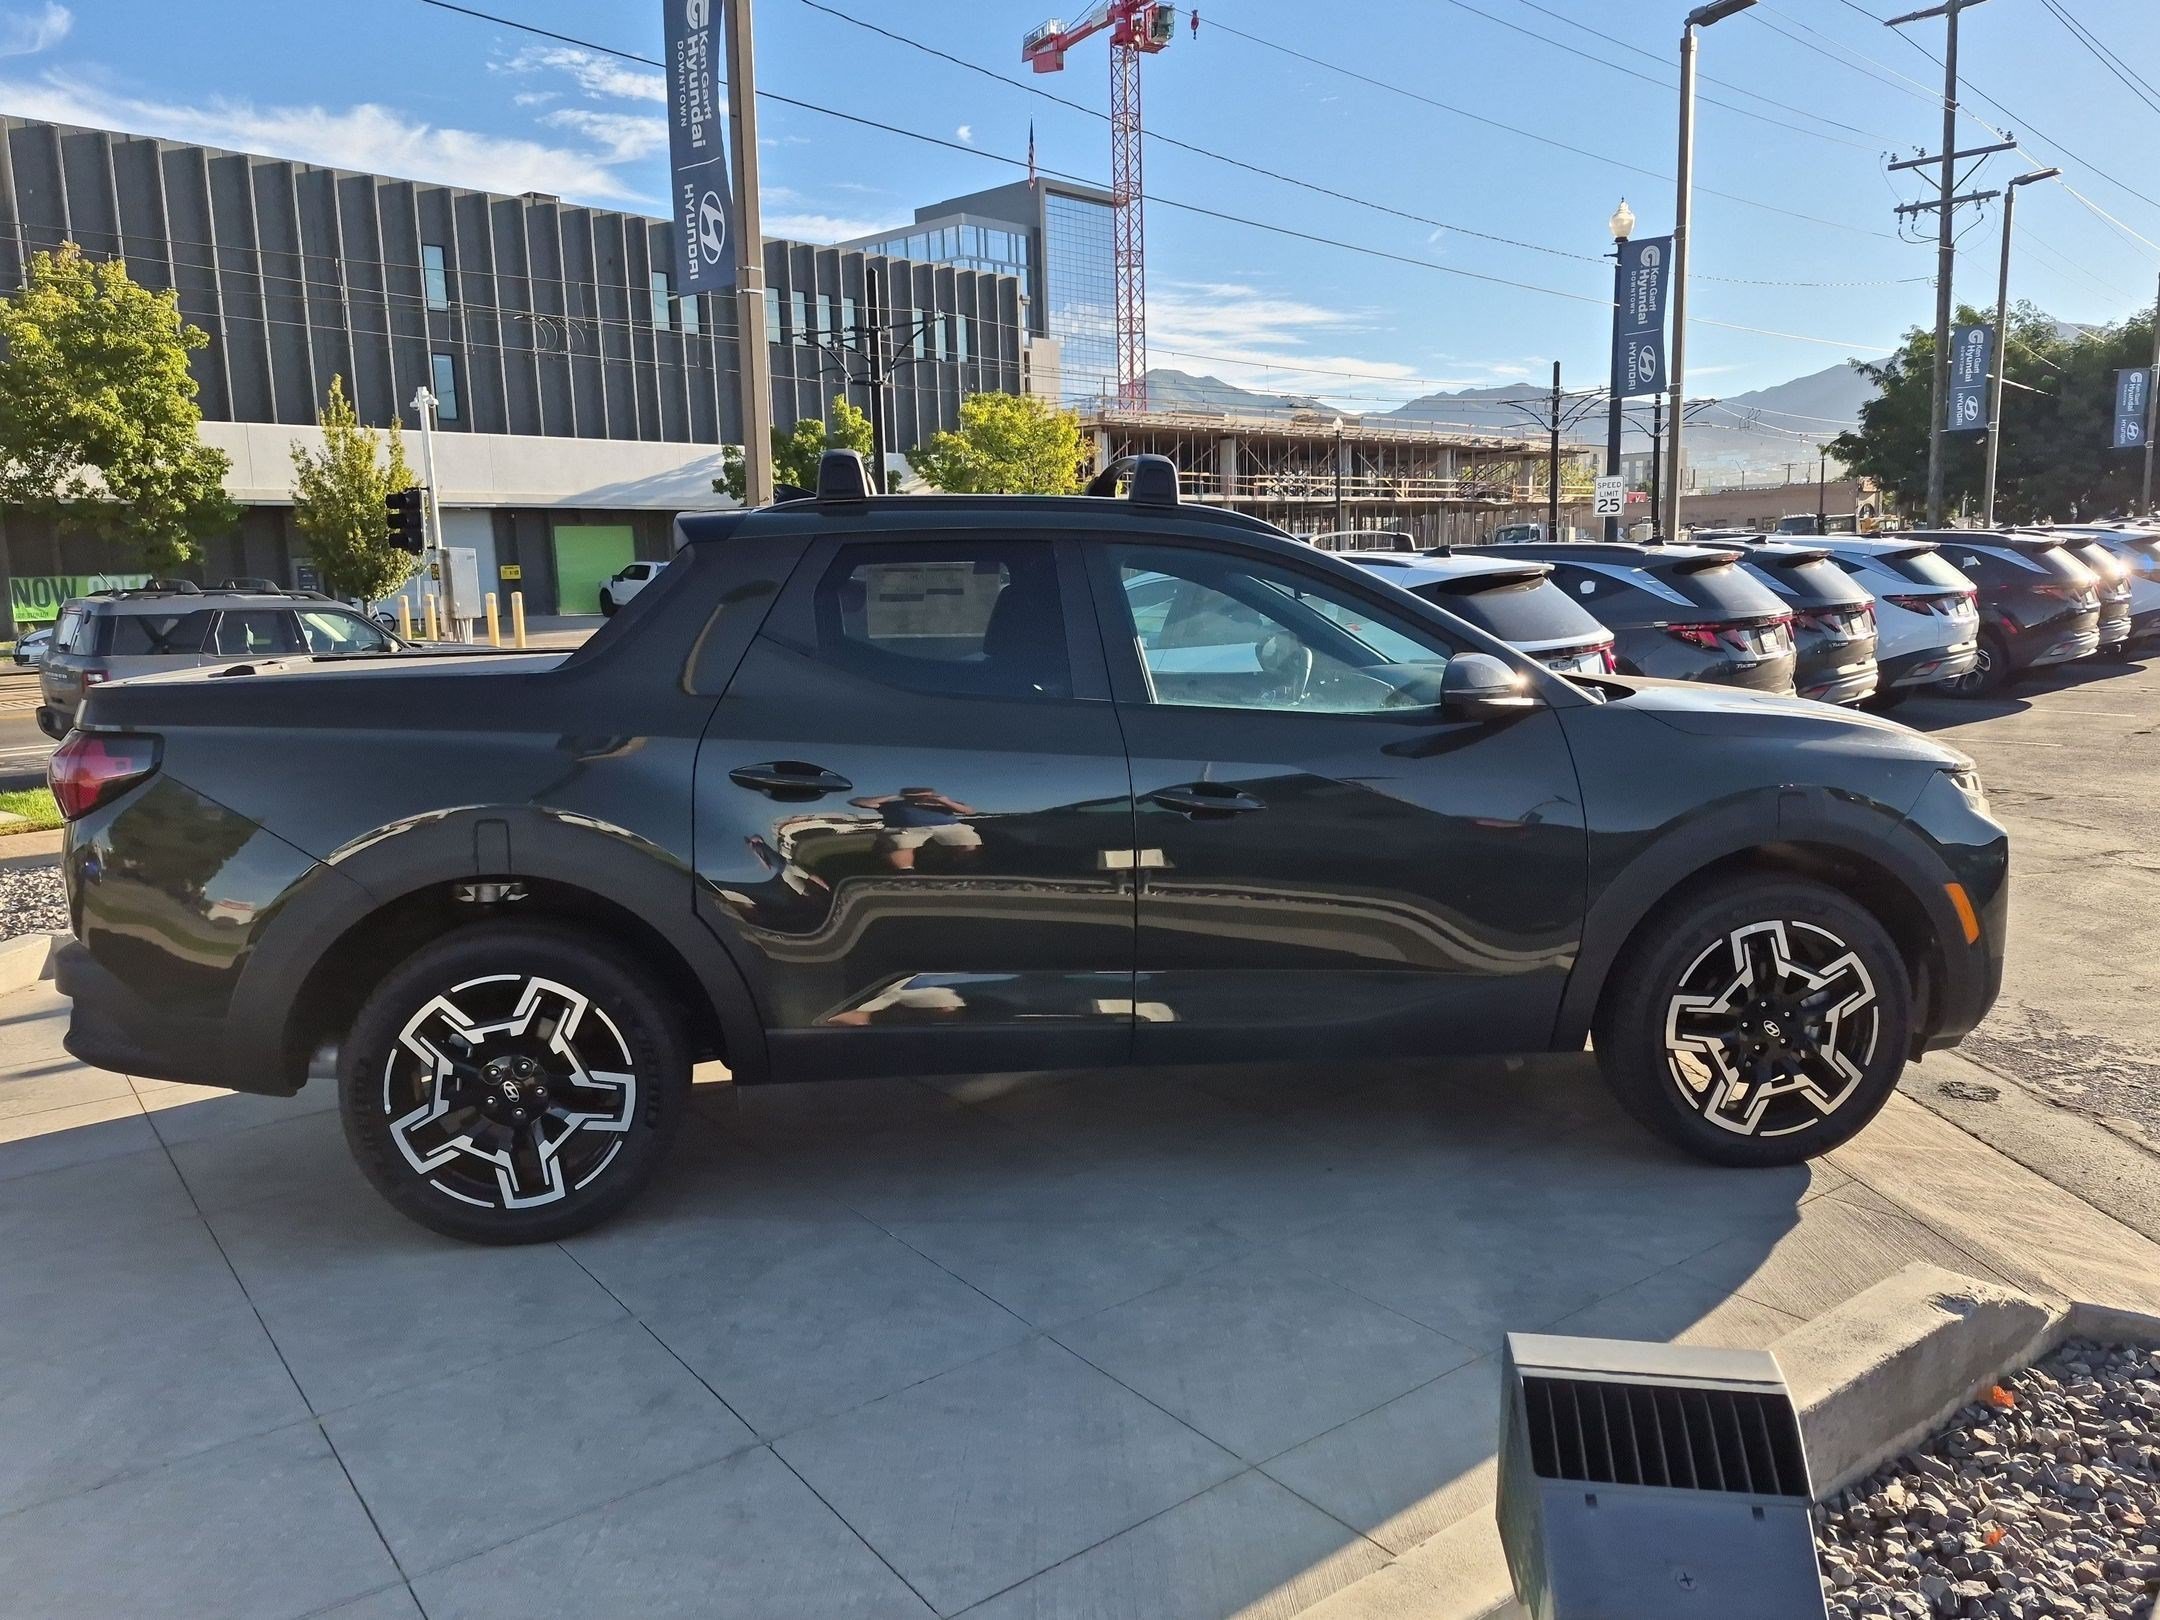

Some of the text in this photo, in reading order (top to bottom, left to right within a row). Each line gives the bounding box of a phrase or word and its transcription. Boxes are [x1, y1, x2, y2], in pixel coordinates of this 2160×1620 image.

[676, 40, 687, 128] DOWNTOWN
[686, 35, 706, 149] Hyundai
[699, 31, 713, 120] Ken Garff
[683, 183, 700, 281] HYUNDAI
[1629, 271, 1637, 315] DOWNTOWN
[1637, 269, 1650, 325] Hyundai
[1650, 266, 1659, 286] Ken
[1627, 342, 1637, 391] HYUNDAI
[1965, 344, 1975, 382] Hyundai
[1597, 481, 1622, 489] SPEED
[1597, 498, 1620, 513] 25
[1599, 490, 1619, 498] LIMIT
[10, 574, 153, 608] NOW OPE
